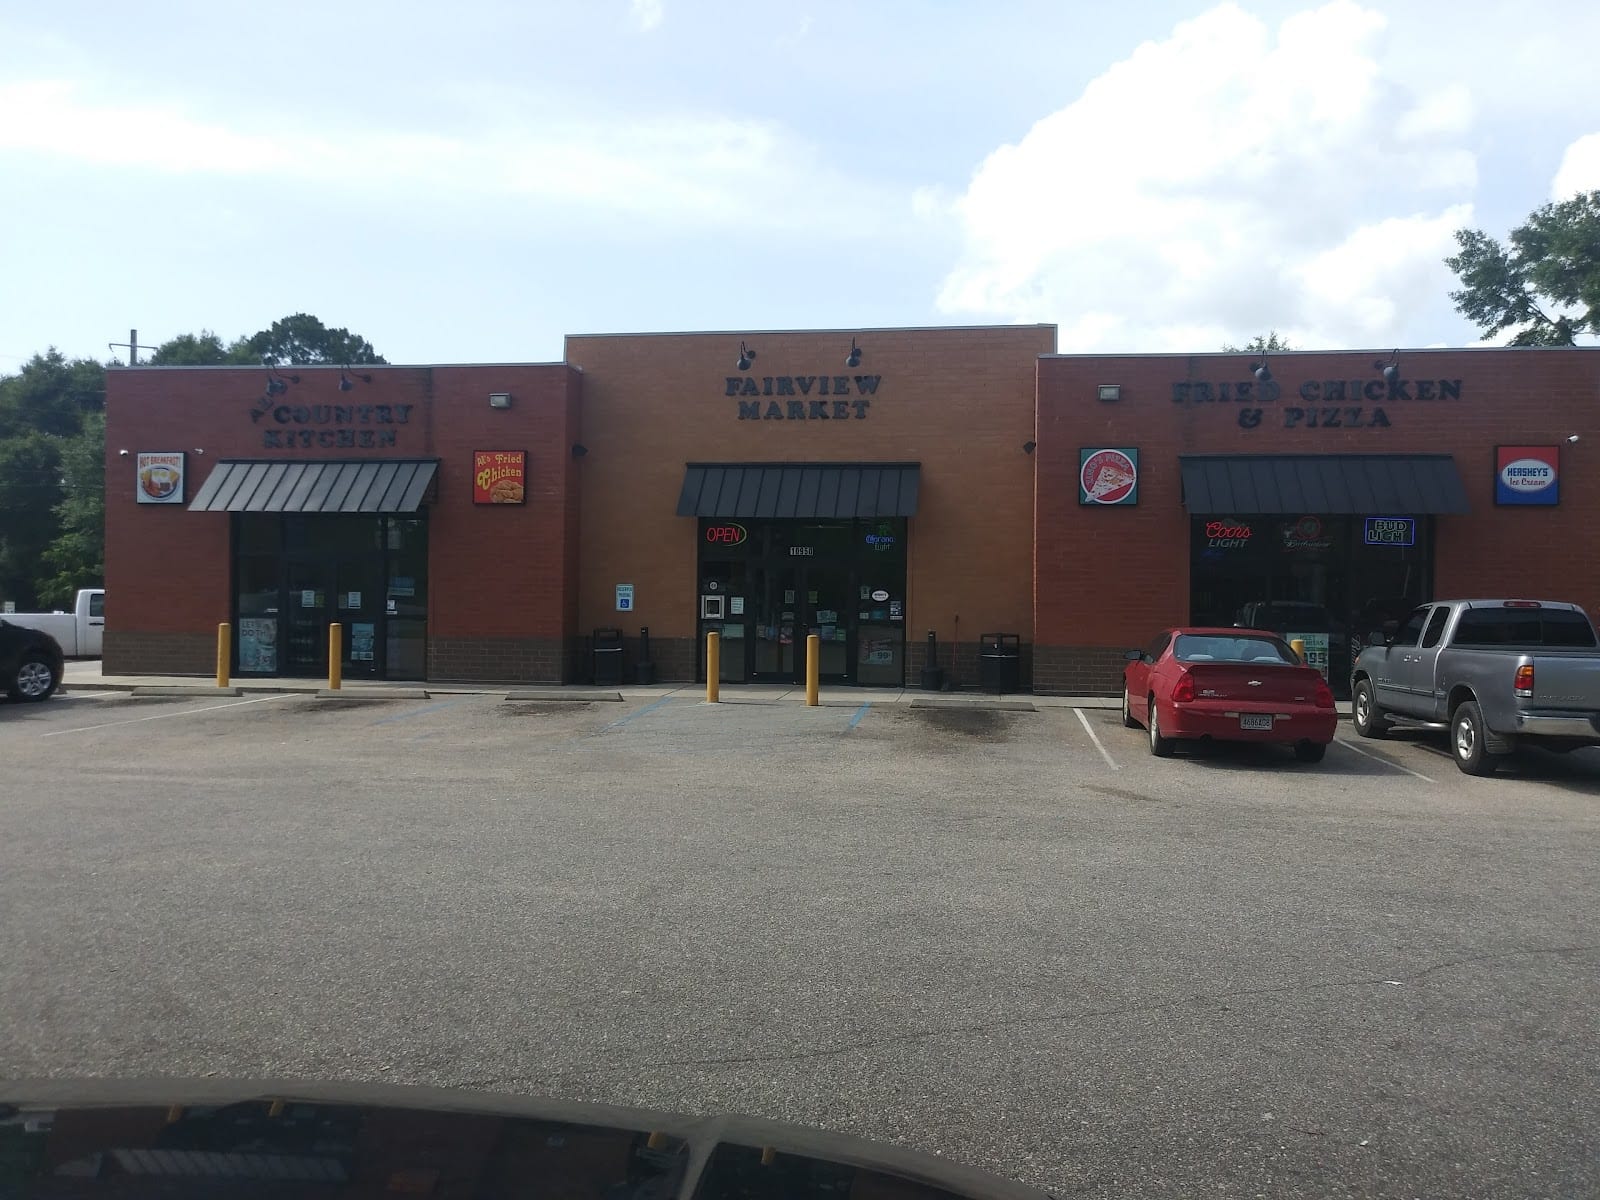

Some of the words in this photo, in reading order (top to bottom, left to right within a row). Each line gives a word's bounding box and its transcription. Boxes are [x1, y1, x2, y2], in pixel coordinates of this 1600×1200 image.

[725, 375, 882, 396] FAIRVIEW
[1171, 380, 1281, 402] FRIED
[1300, 379, 1463, 401] CHICKEN
[273, 405, 413, 425] COUNTRY
[737, 401, 870, 420] MARKET
[1238, 407, 1263, 428] &
[1284, 407, 1391, 428] PIZZA
[263, 430, 398, 449] KITCHEN
[495, 454, 522, 464] Fried
[477, 466, 521, 490] Chicken
[1509, 477, 1520, 486] Ice
[1521, 477, 1546, 486] Cream
[706, 527, 740, 542] OPEN
[1206, 521, 1252, 538] Coors
[1375, 520, 1407, 531] BUD
[1208, 539, 1249, 548] LIGHT
